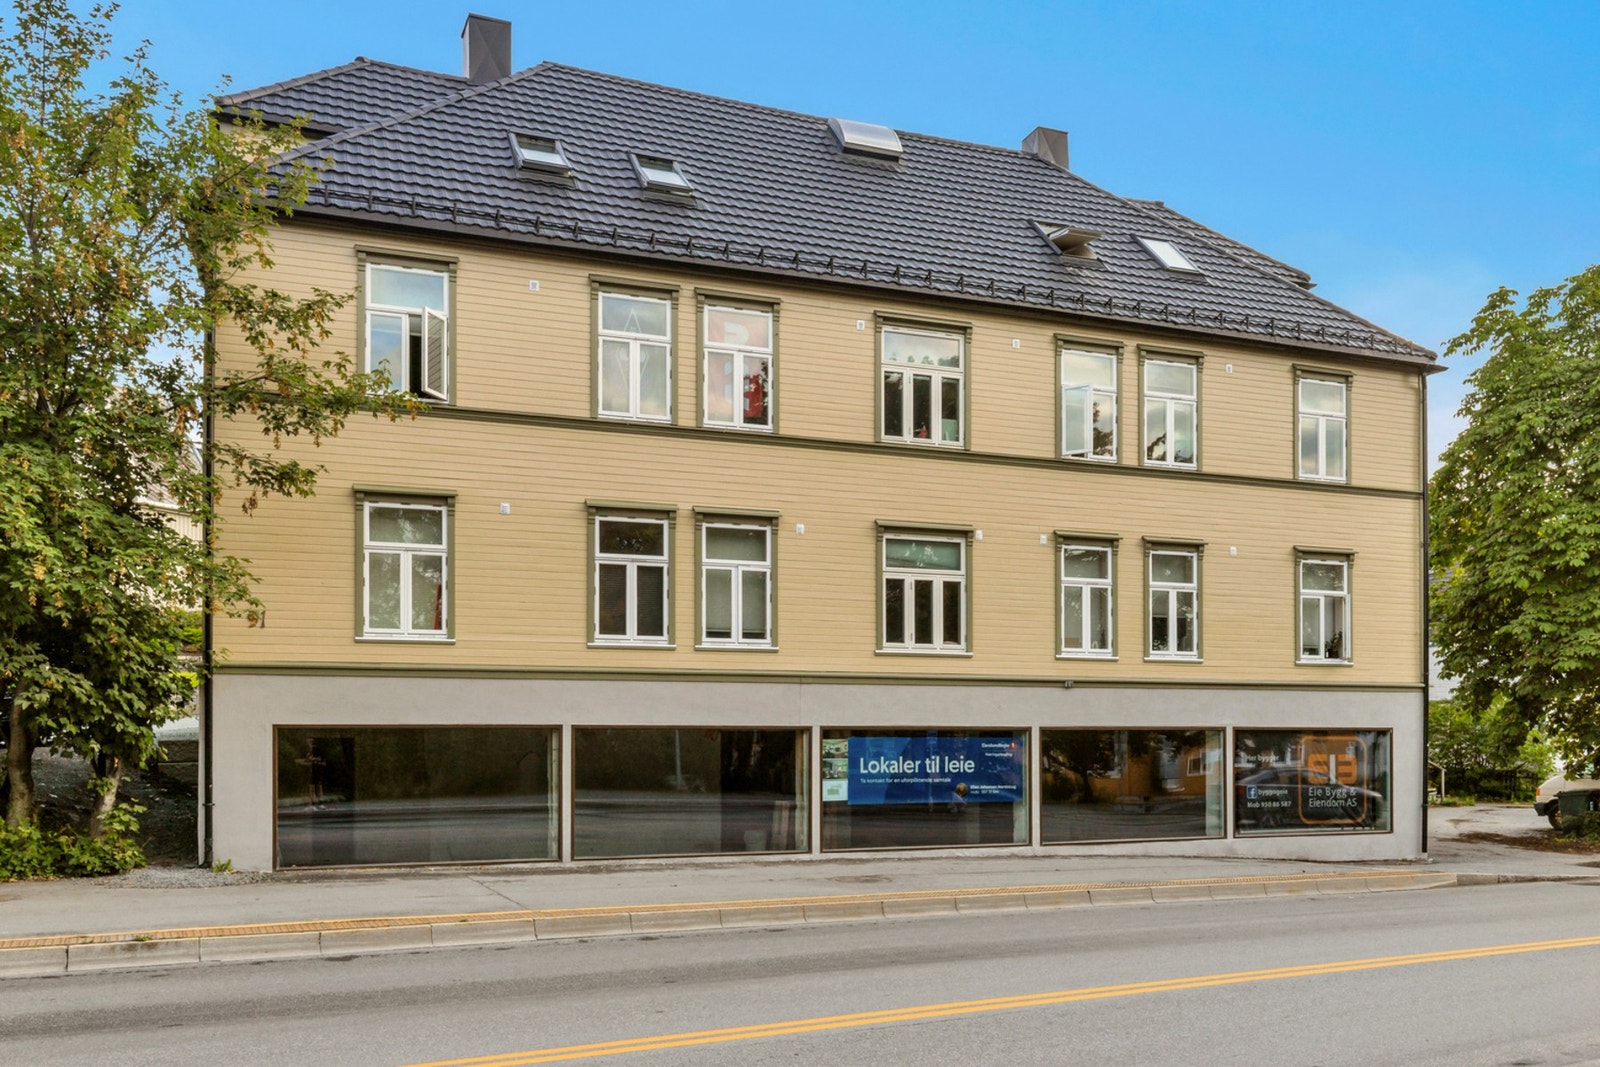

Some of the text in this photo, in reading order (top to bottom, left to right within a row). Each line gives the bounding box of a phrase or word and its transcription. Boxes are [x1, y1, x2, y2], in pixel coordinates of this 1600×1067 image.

[860, 755, 975, 774] Lokaler til leie
[1326, 787, 1347, 799] Bygg
[1350, 788, 1357, 796] &
[1309, 798, 1358, 807] Eiendom AS
